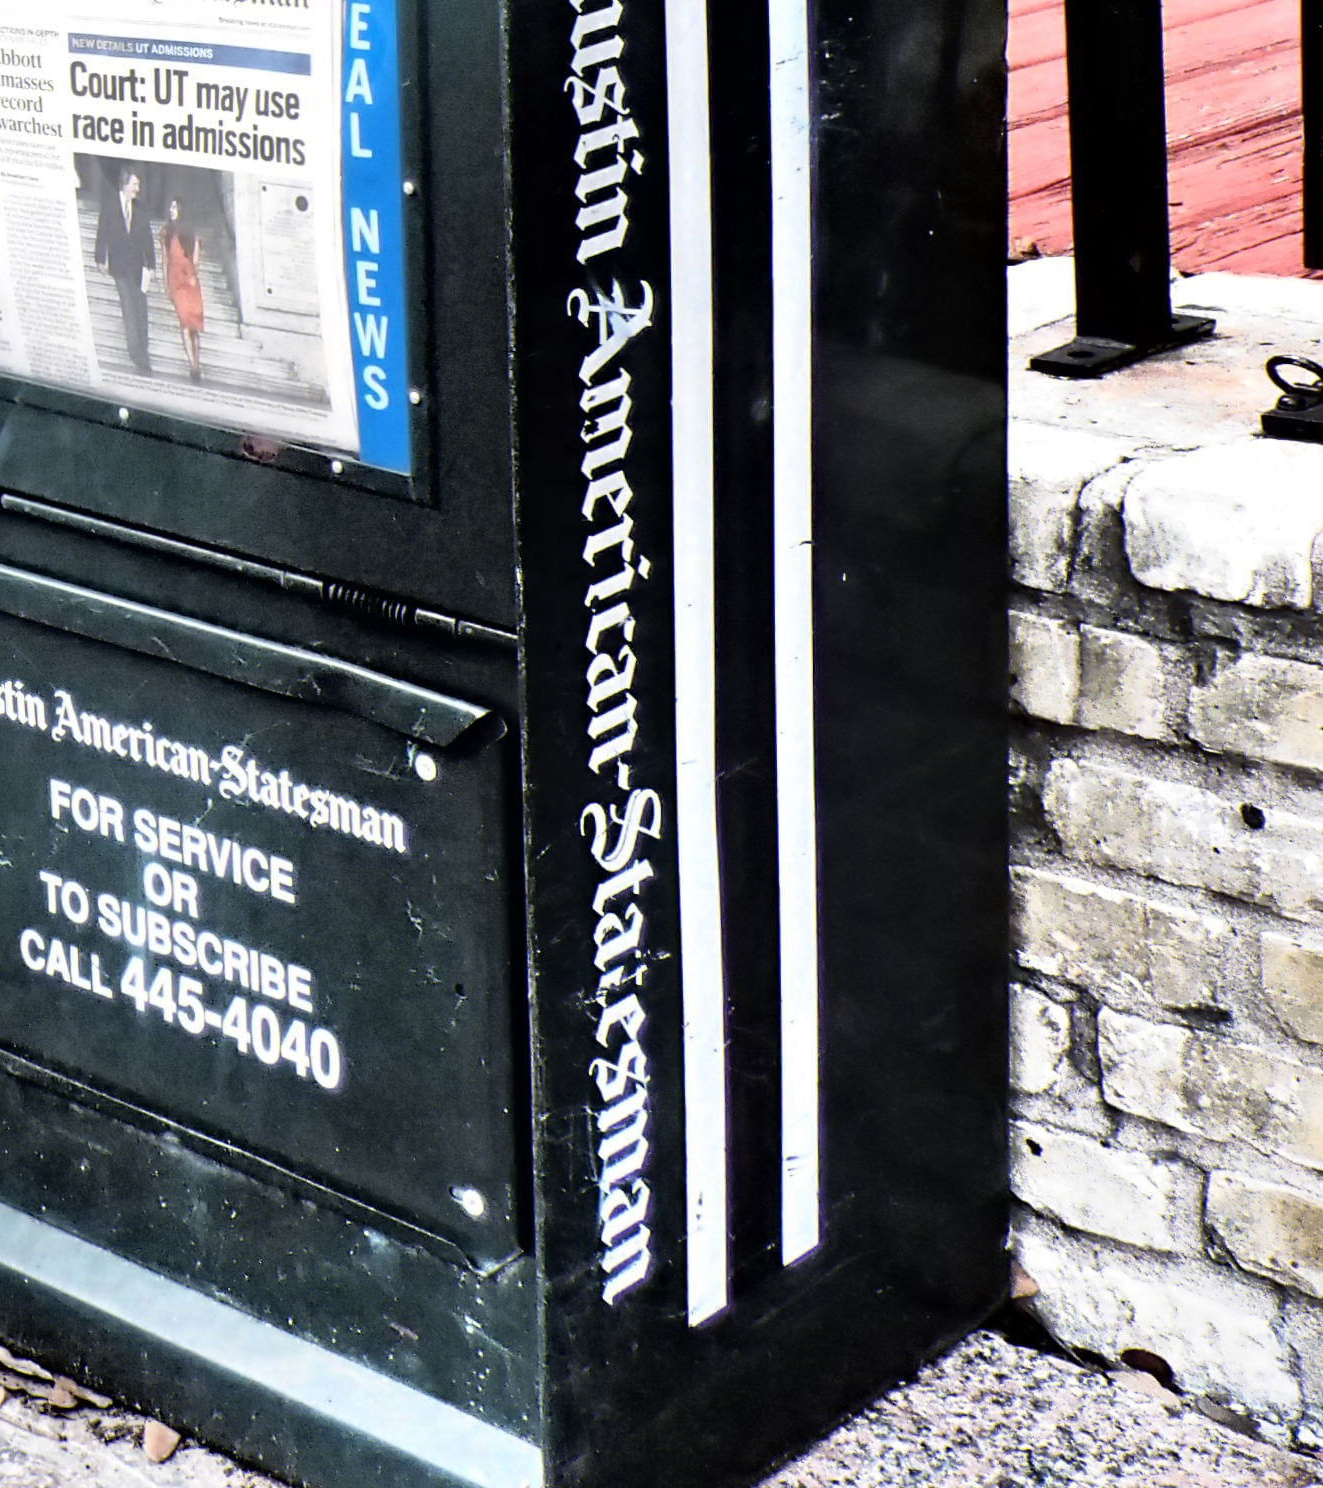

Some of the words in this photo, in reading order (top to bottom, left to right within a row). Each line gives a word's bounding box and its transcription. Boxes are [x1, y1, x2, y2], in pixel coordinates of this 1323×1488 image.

[70, 60, 146, 104] Court:
[154, 67, 189, 107] UT
[196, 81, 249, 122] may
[256, 88, 300, 120] use
[72, 38, 95, 50] NEW
[96, 40, 134, 53] DETAILS
[135, 43, 149, 54] UT
[151, 44, 214, 59] ADMISSIONS
[72, 113, 125, 145] race
[132, 110, 155, 148] in
[162, 114, 306, 166] admissions
[350, 206, 390, 412] NEWS
[50, 688, 408, 855] American-Statesman
[566, 279, 663, 1307] American-Statesman
[49, 778, 126, 843] FOR
[133, 807, 297, 905] SERVICE
[143, 861, 200, 918] OR
[19, 928, 115, 999] CALL
[120, 956, 342, 1091] 445-4040
[39, 871, 90, 925] TO
[97, 891, 314, 1014] SUBSCRIBE
